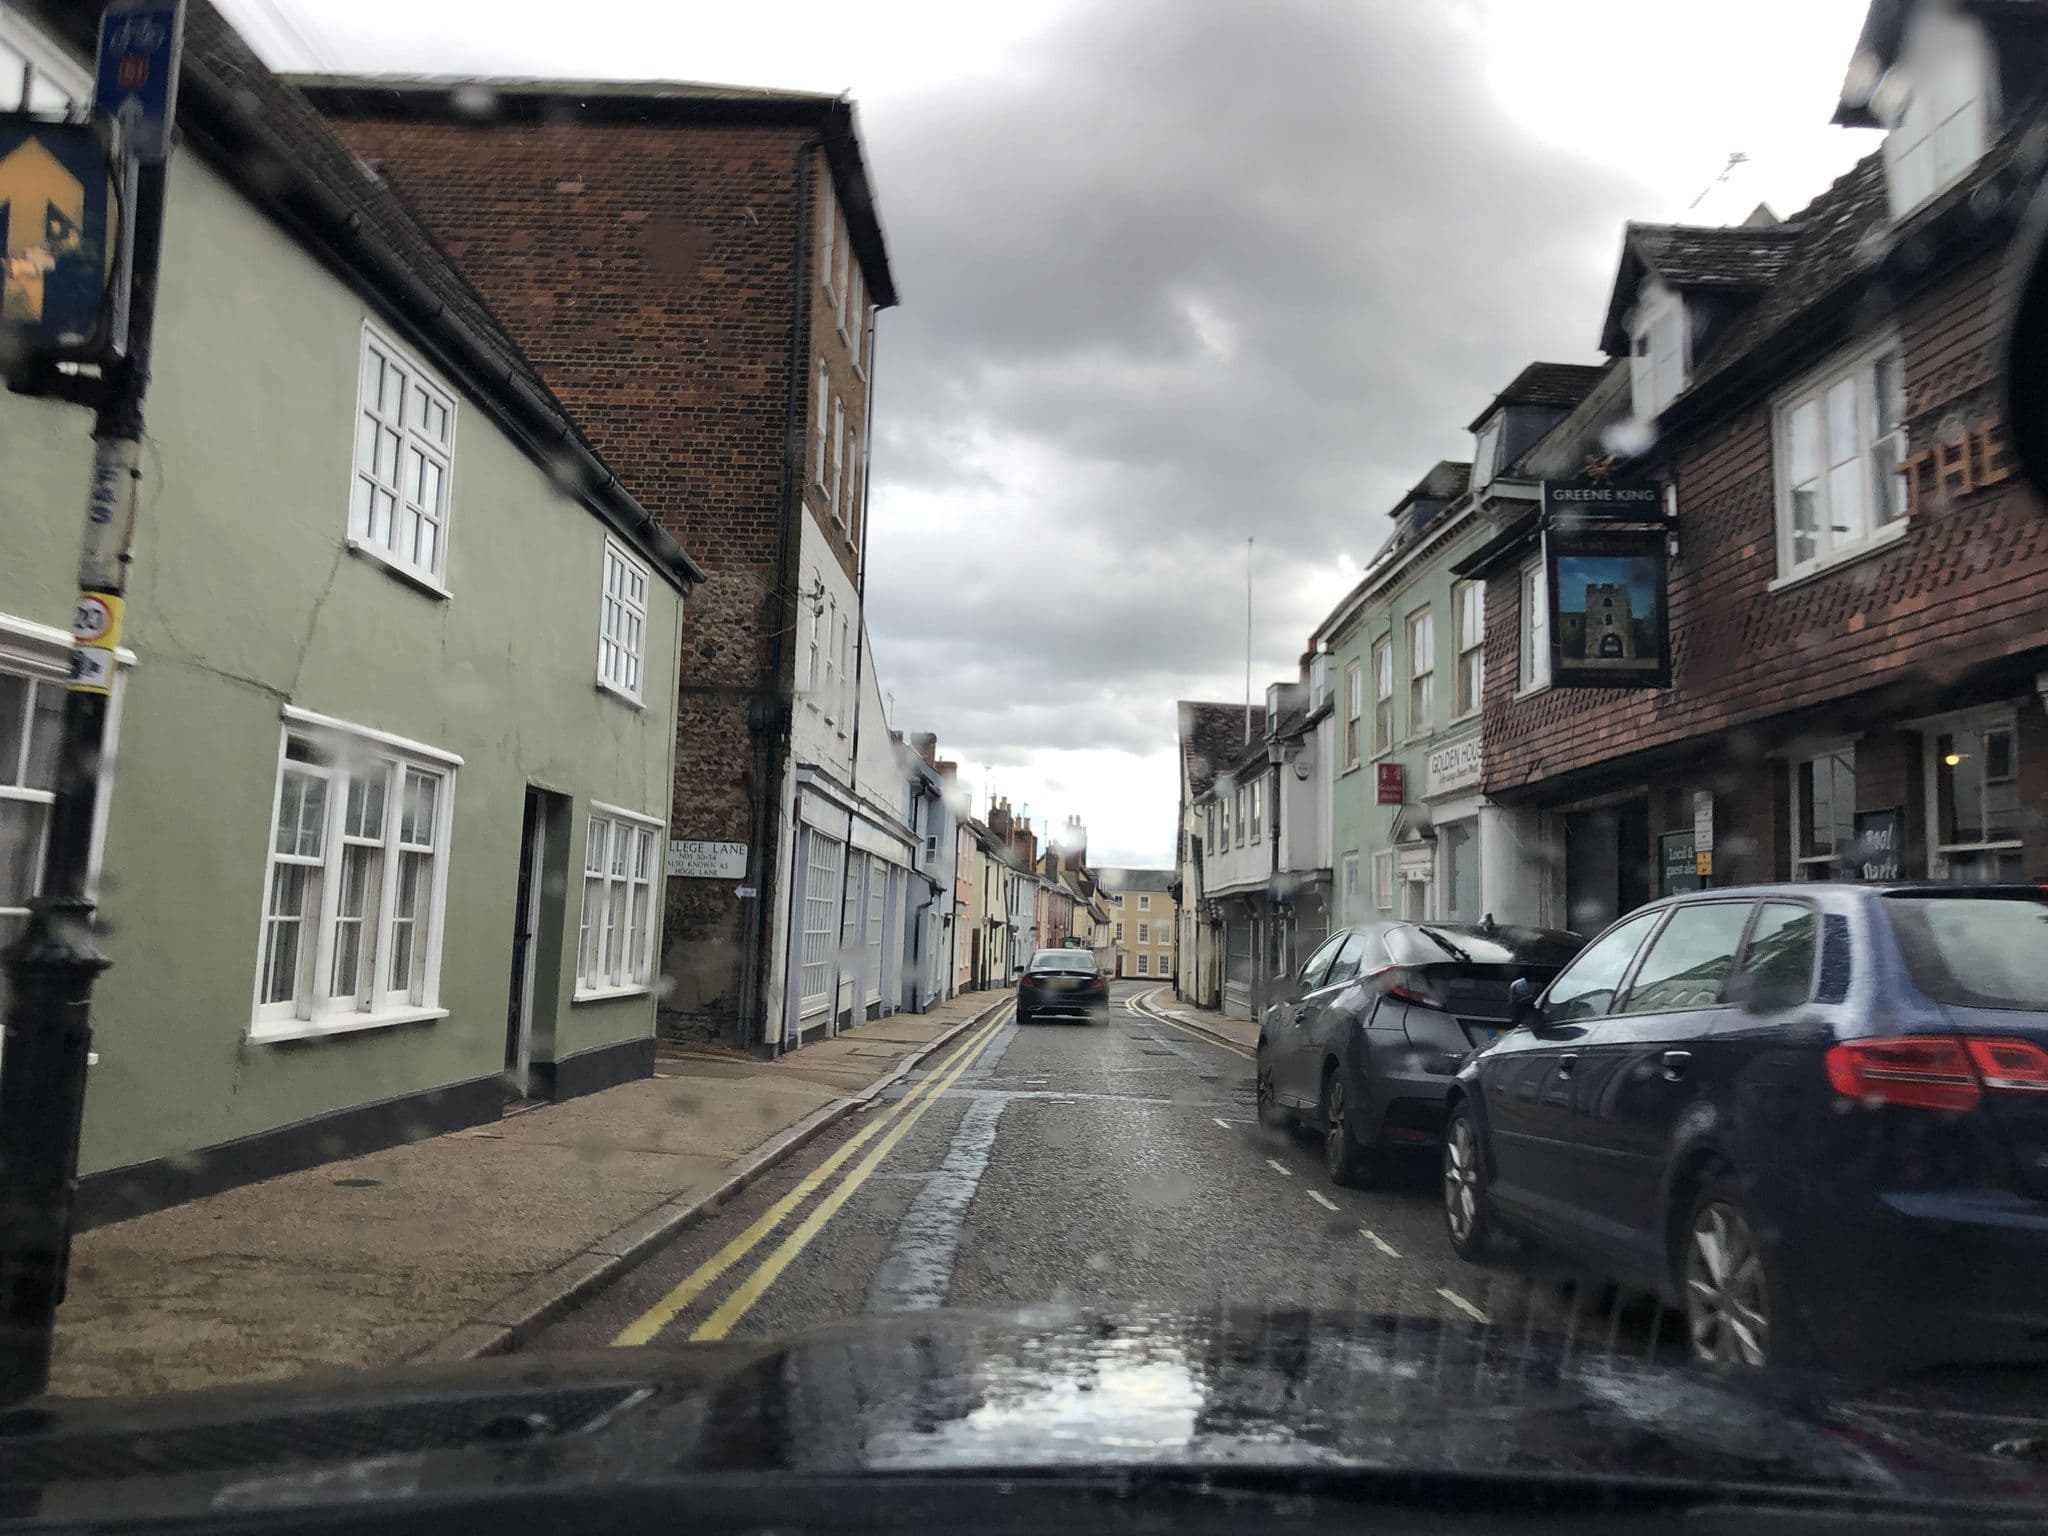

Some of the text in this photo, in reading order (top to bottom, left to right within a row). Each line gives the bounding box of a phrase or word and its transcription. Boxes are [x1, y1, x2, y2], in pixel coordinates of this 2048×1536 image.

[1893, 415, 2015, 516] THE
[1552, 488, 1656, 502] GREENE KING
[1431, 749, 1460, 774] GOLDEN
[712, 843, 745, 855] LANE
[1668, 845, 1687, 861] Local
[688, 861, 716, 869] KNOWN
